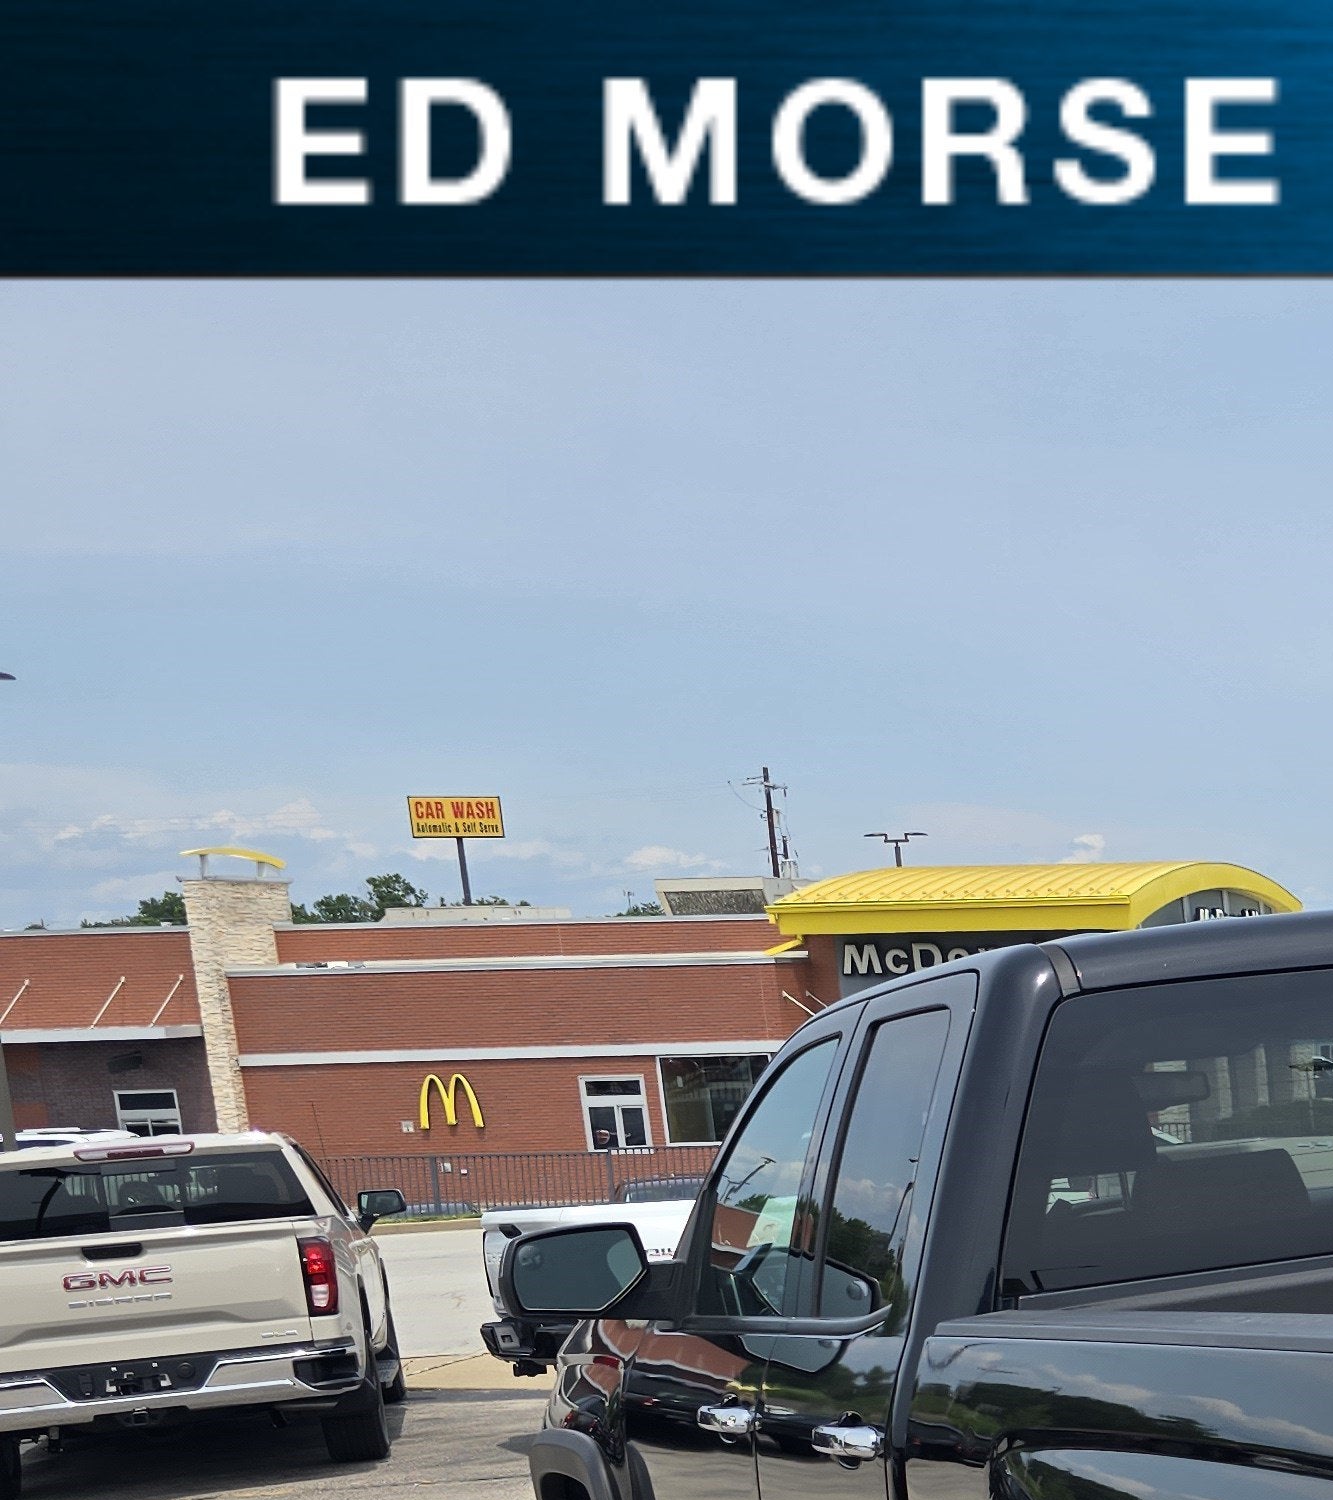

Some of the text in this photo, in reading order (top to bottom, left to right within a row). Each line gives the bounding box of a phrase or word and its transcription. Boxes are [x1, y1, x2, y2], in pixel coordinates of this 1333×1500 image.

[414, 801, 496, 820] CAR WASH
[416, 822, 452, 833] Automatic
[462, 822, 477, 833] Self
[479, 821, 500, 834] Serve
[61, 1265, 173, 1293] GMC
